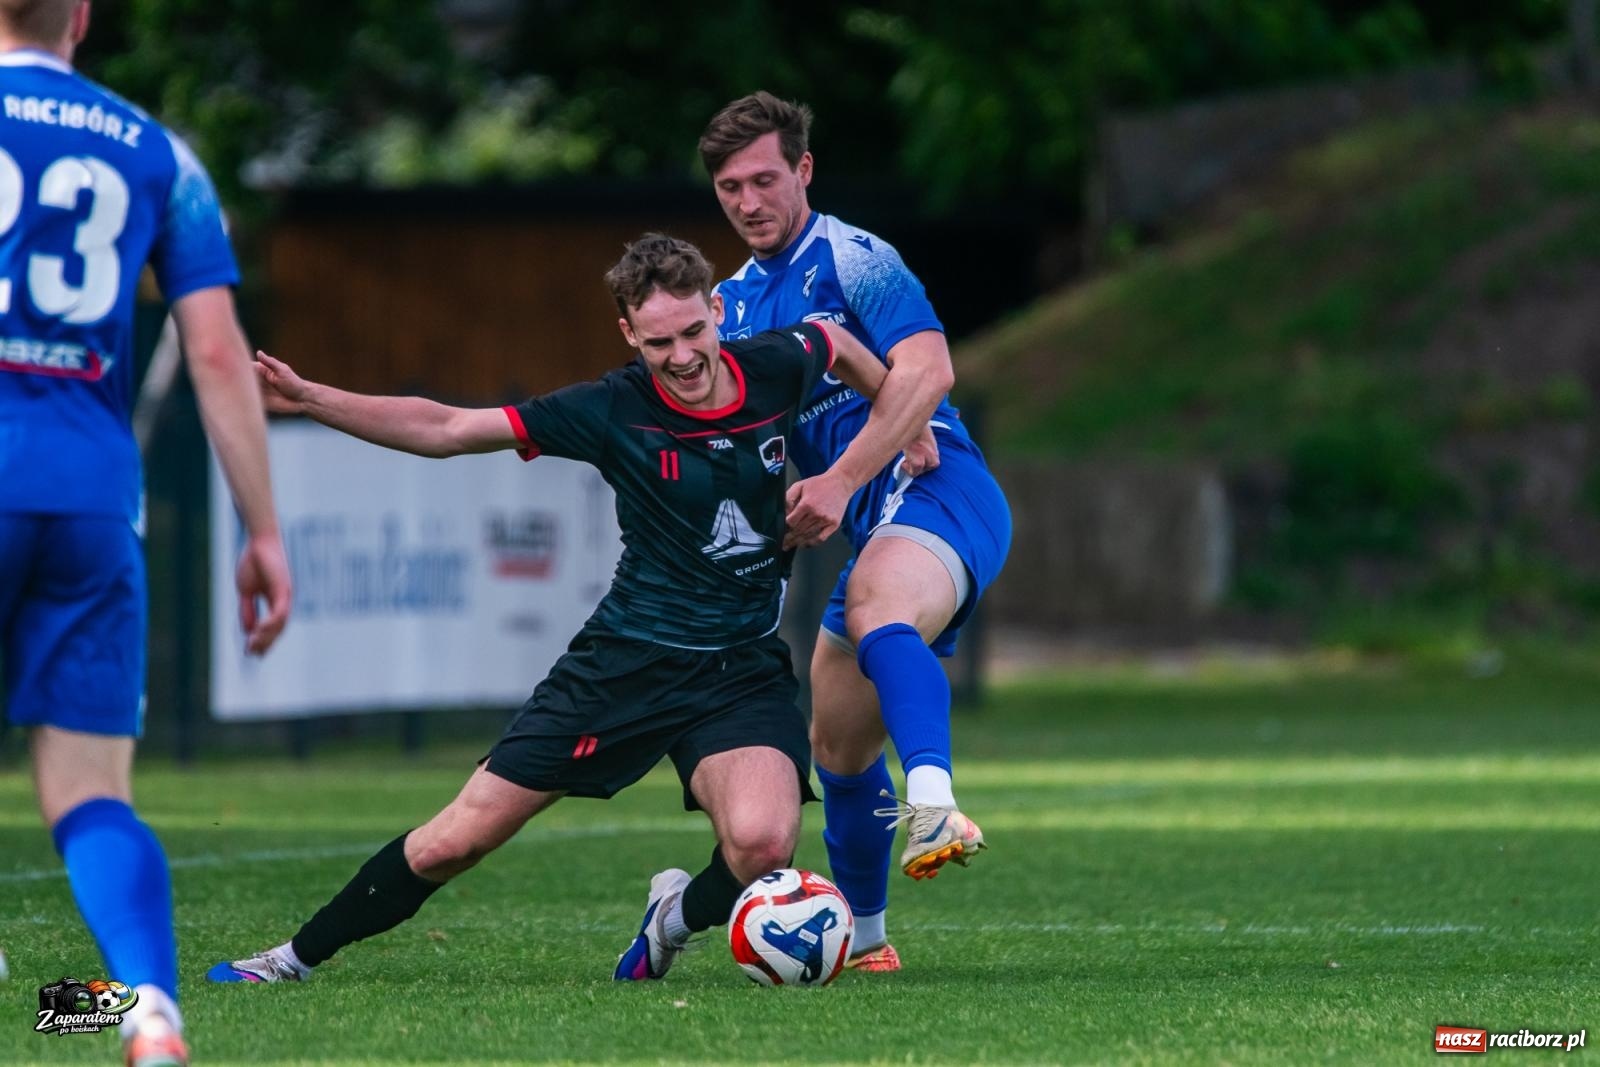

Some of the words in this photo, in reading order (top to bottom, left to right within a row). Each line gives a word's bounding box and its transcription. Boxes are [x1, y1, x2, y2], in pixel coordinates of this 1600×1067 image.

[3, 94, 143, 148] RACIBÓRZ
[0, 146, 129, 324] 3
[659, 450, 680, 481] 11
[735, 557, 775, 576] GROUP
[572, 735, 598, 760] 11
